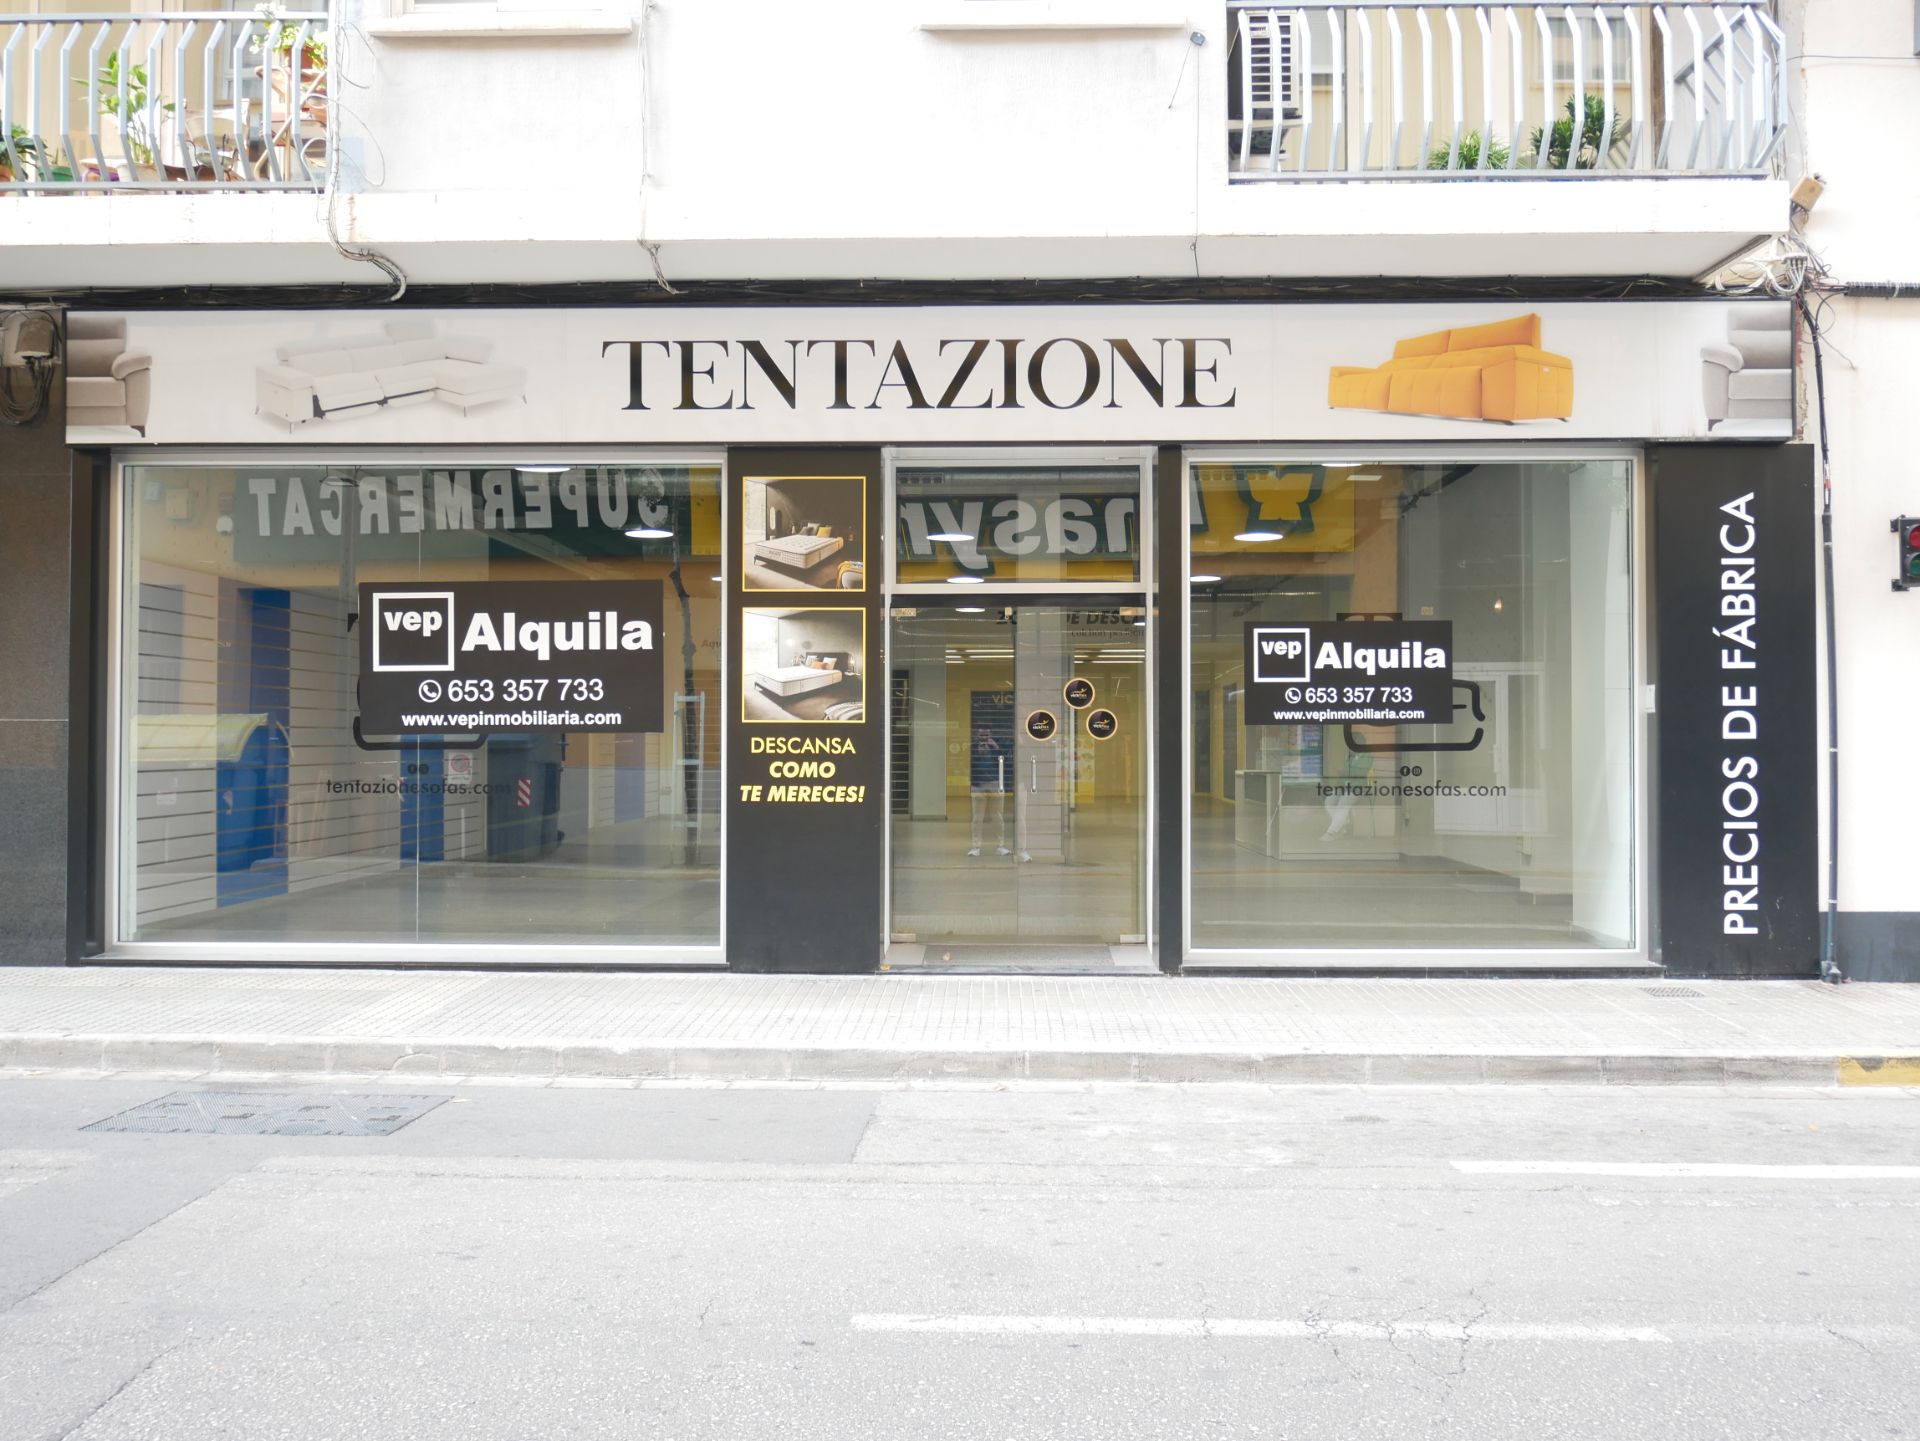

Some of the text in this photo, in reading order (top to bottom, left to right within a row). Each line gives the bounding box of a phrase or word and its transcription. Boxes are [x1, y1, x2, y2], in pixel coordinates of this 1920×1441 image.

[601, 338, 1237, 410] TENTAZIONE
[384, 611, 442, 637] vep
[461, 611, 653, 661] Alquila
[1261, 640, 1302, 660] vep
[1314, 642, 1447, 676] Alquila
[447, 678, 604, 702] 653 357 733
[1304, 686, 1413, 704] 653 357 733
[401, 710, 622, 729] www.vepinmobiliaria.com
[1273, 708, 1425, 722] www.vepinmobiliaria.com
[1712, 492, 1759, 935] PRECIOS DE FÁBRICA
[750, 736, 856, 754] DESCANSA
[769, 761, 836, 778] COMO
[326, 779, 512, 796] tentazionesofas.com
[740, 785, 865, 803] TE MERECES!
[1316, 779, 1507, 797] tentazionesofas.com
